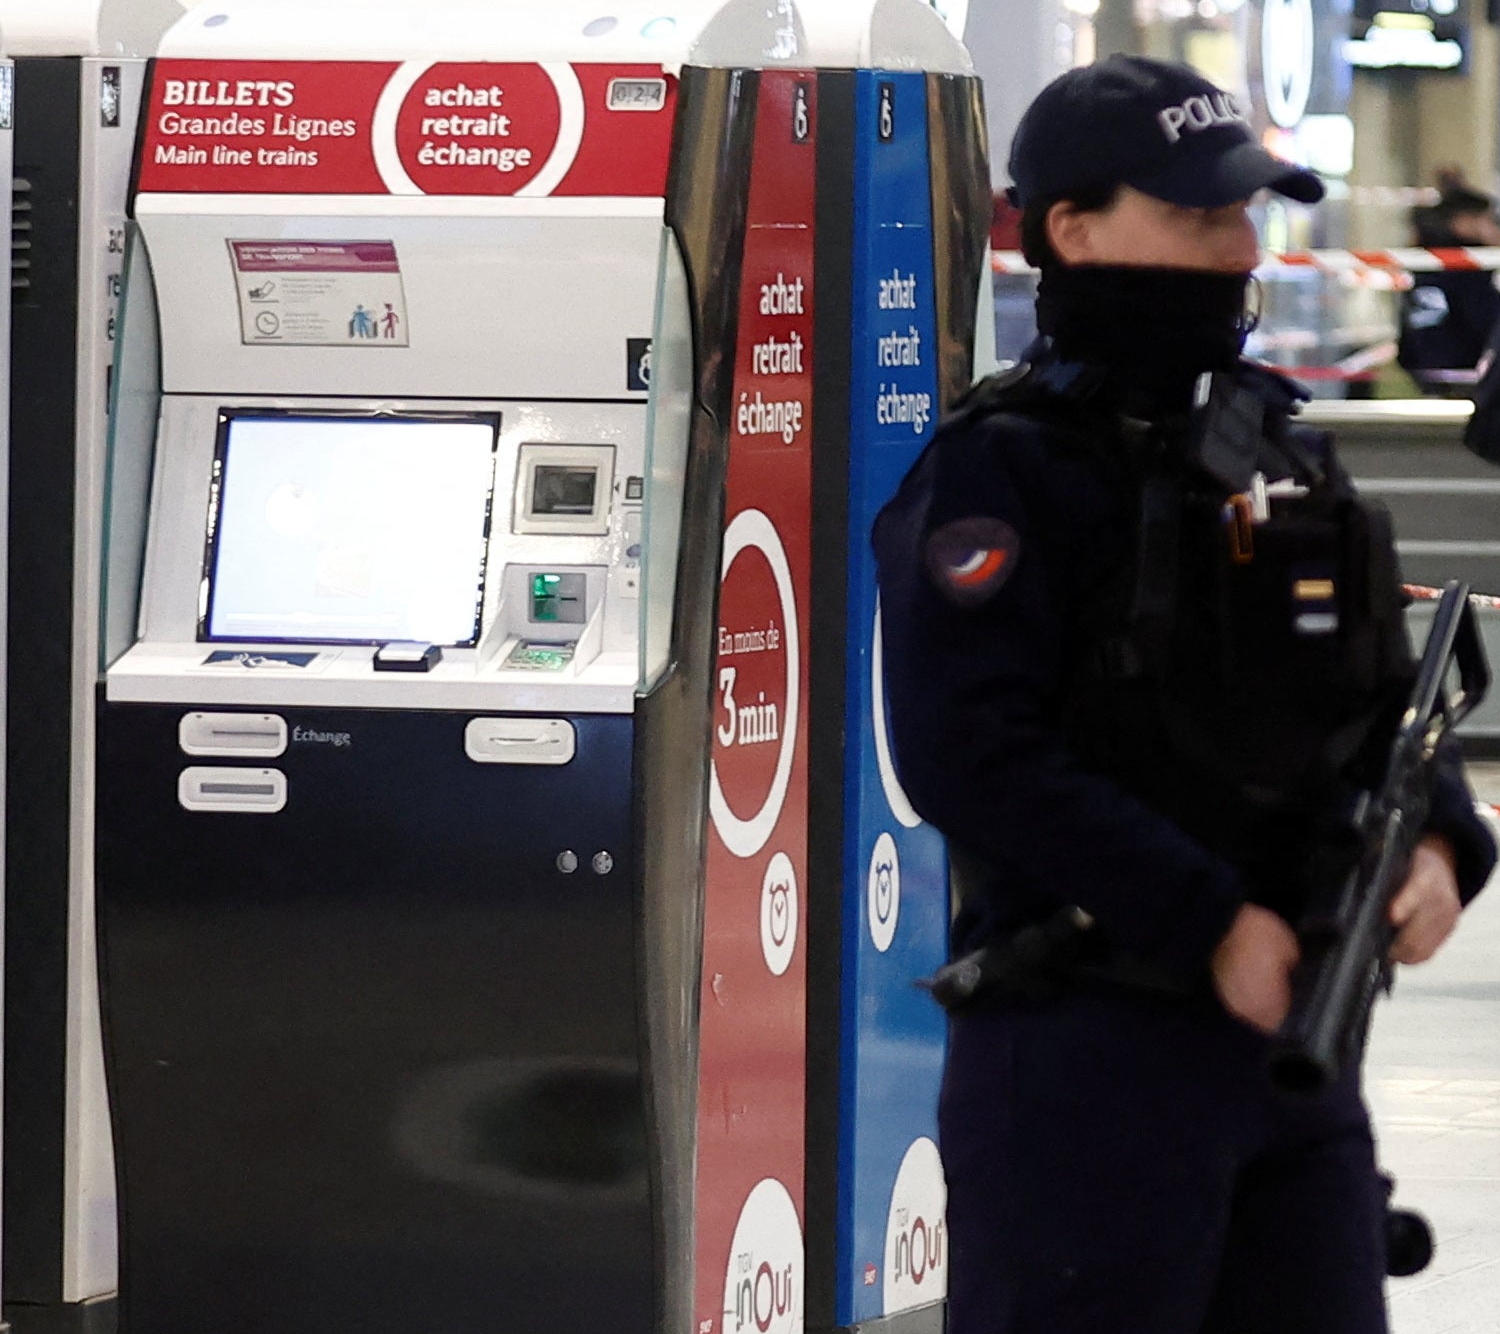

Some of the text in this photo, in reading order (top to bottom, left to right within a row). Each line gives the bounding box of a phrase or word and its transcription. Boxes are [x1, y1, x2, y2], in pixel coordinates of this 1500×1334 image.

[163, 80, 295, 107] BILLETS
[425, 84, 502, 108] achat
[159, 112, 356, 140] Grandes Lignes
[422, 113, 511, 138] retrait
[1159, 93, 1244, 144] POLIC
[156, 145, 319, 167] Main line trains
[418, 142, 531, 172] échange
[760, 272, 803, 315] achat
[879, 268, 916, 310] achat
[753, 331, 803, 375] retrait
[878, 325, 920, 367] retrait
[737, 391, 802, 445] échange
[876, 383, 930, 434] échange
[718, 621, 779, 655] En moins de
[717, 667, 779, 748] 3 min
[293, 725, 352, 749] Échange
